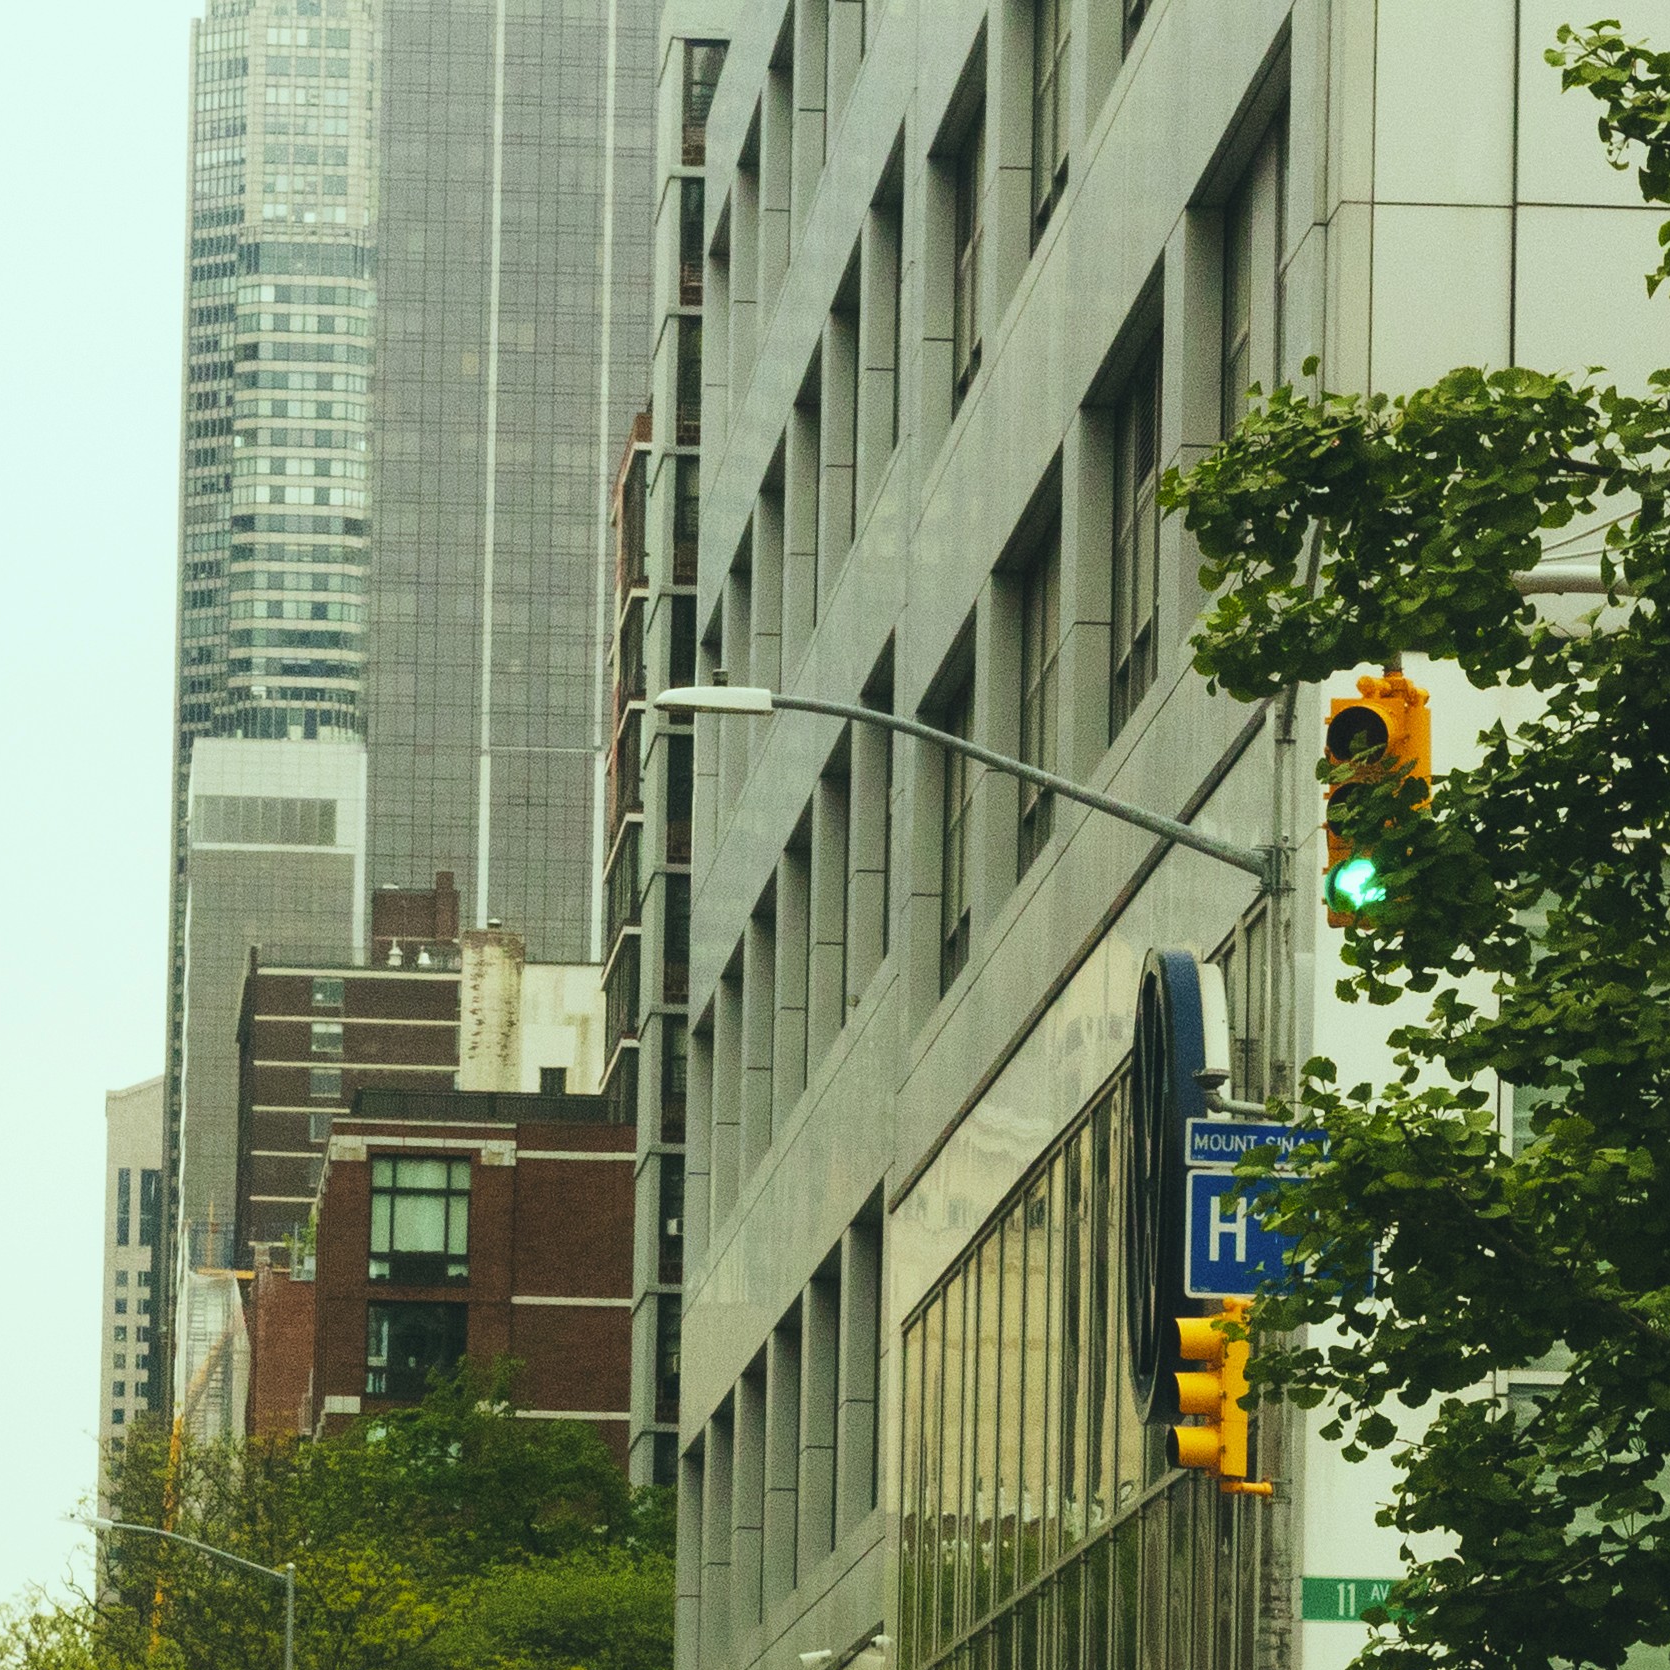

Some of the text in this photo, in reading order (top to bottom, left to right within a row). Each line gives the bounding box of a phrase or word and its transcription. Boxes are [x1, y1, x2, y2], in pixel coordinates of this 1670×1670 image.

[1194, 1133, 1258, 1153] MOUNT
[1265, 1136, 1314, 1154] SIN
[1336, 1583, 1390, 1617] 11 AV
